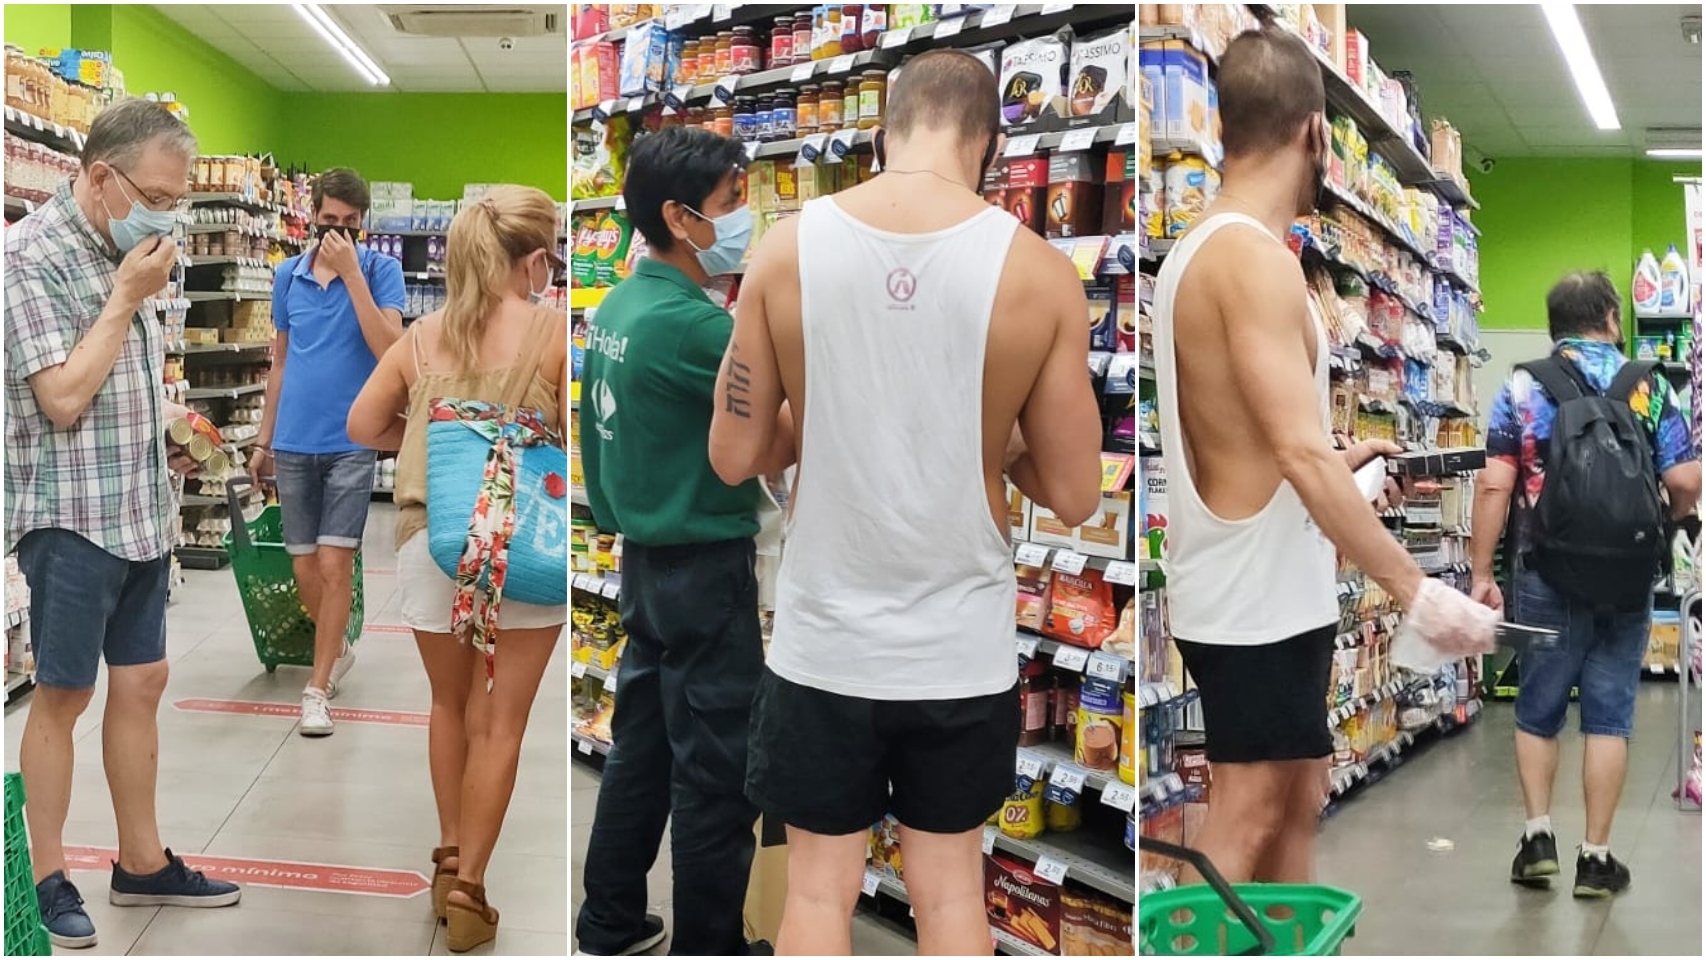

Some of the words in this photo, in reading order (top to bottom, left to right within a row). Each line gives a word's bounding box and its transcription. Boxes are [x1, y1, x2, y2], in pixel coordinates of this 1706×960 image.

[586, 323, 629, 363] ¡Hola!
[1006, 806, 1027, 822] 0%
[221, 867, 318, 880] mínimo
[993, 874, 1051, 908] Napolitanas
